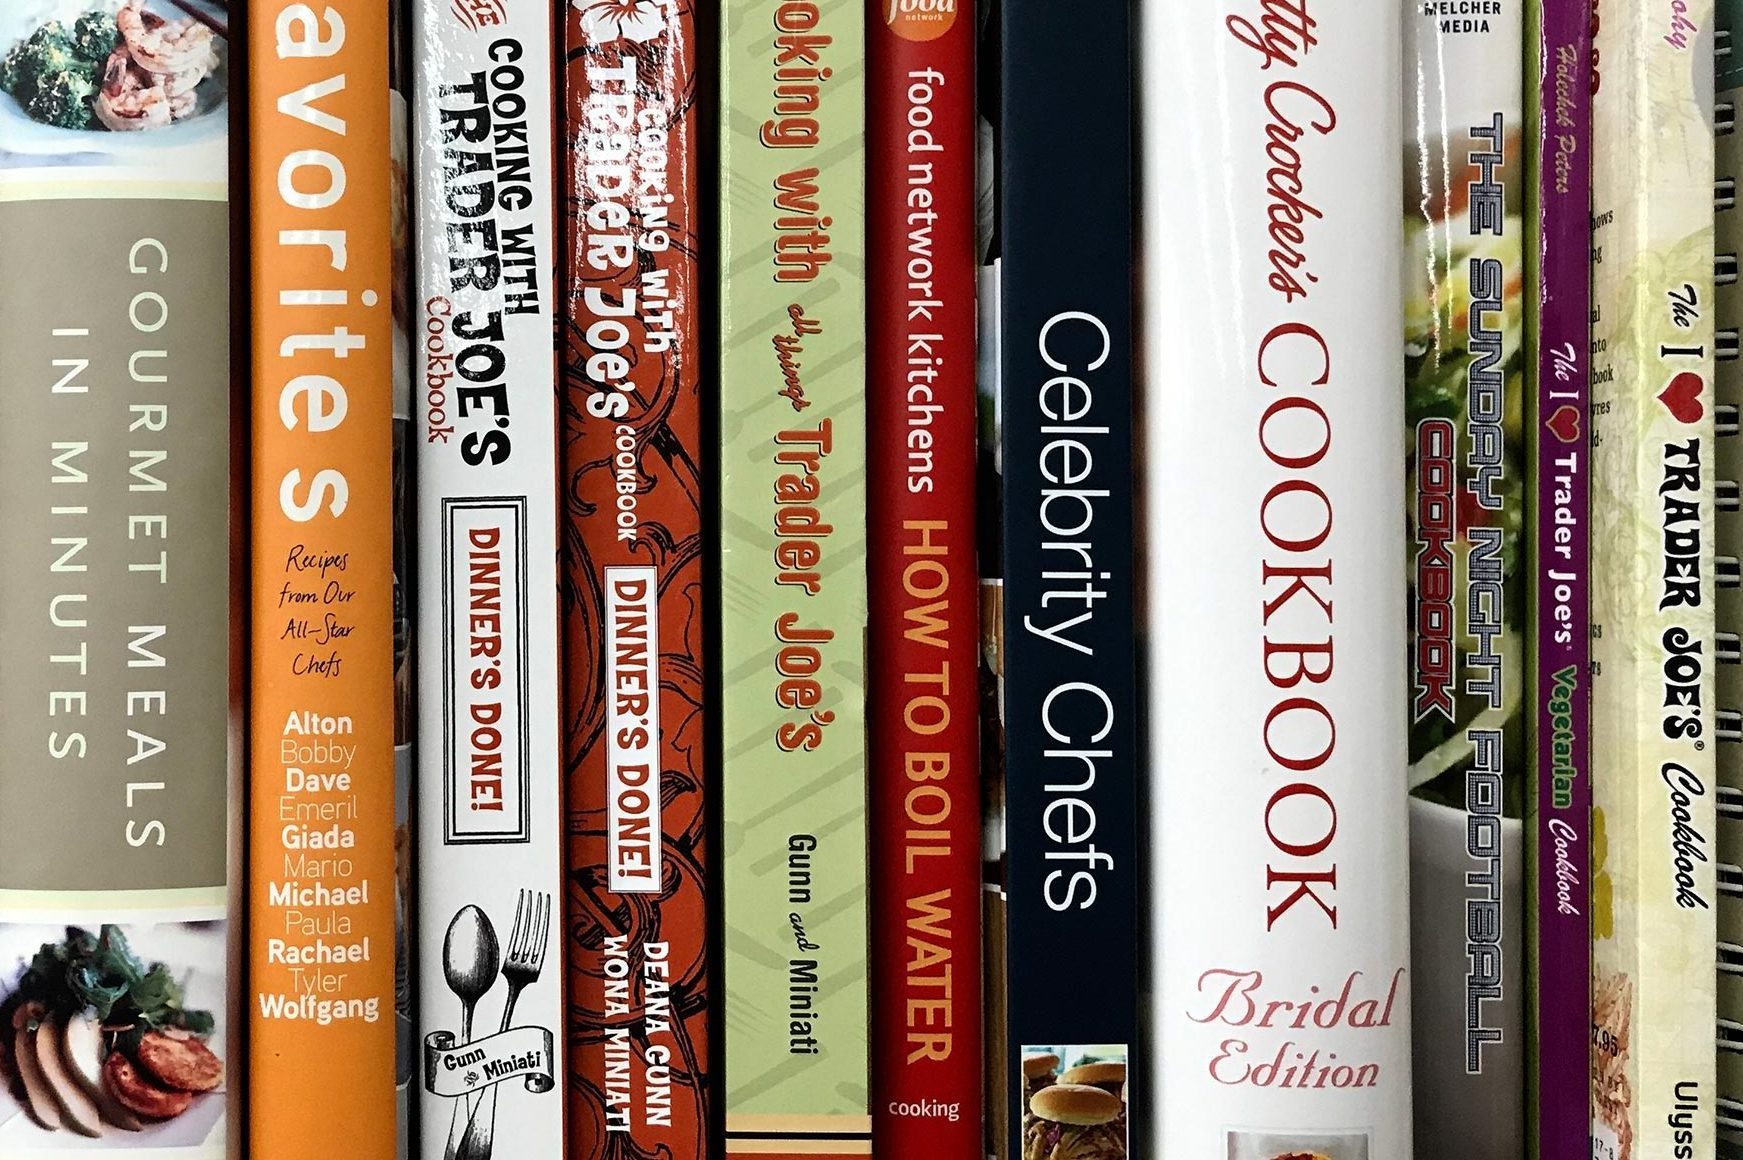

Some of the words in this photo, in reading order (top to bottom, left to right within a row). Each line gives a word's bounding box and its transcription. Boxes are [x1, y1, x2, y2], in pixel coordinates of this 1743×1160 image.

[905, 13, 944, 22] network
[1424, 1, 1501, 16] MELCHER
[1440, 19, 1490, 34] MEDIA
[760, 0, 832, 148] oking
[907, 67, 944, 152] food
[488, 38, 534, 211] COOKING
[1554, 135, 1577, 194] Peters
[439, 70, 502, 294] TRADER
[1262, 80, 1336, 304] Crocker's
[1468, 112, 1503, 236] THE
[276, 3, 378, 522] avorites
[501, 223, 540, 316] WITH
[773, 167, 832, 282] with
[907, 163, 944, 321] network
[787, 303, 822, 337] all
[1660, 345, 1704, 358] I
[1668, 284, 1699, 328] The
[51, 328, 89, 393] IN
[424, 297, 453, 445] Cookbook
[451, 305, 512, 467] JOE'S
[773, 333, 811, 412] things
[1467, 258, 1503, 510] SUNDAY
[1549, 390, 1578, 400] I
[1550, 342, 1577, 382] The
[128, 237, 168, 583] GOURMET
[907, 334, 944, 493] kitchens
[615, 424, 637, 542] COOKBOOK
[774, 417, 834, 596] Trader
[1024, 310, 1112, 656] Celebrity
[1555, 453, 1576, 560] Trader
[1659, 437, 1701, 611] TRADER
[49, 441, 88, 759] MINUTES
[279, 588, 317, 606] from
[324, 587, 356, 605] Our
[286, 545, 349, 573] Recipes
[902, 520, 950, 649] HOW
[1414, 418, 1456, 724] COOKBOOK
[281, 612, 355, 645] All-Star
[469, 527, 502, 690] DINNER'S
[1258, 322, 1337, 932] COOKBOOK
[1466, 528, 1503, 710] NIGHT
[292, 653, 341, 677] Chefs
[614, 579, 650, 750] DINNER'S
[775, 611, 835, 752] Joe's
[903, 661, 951, 735] TO
[125, 625, 167, 847] MEALS
[281, 740, 356, 769] Bobby
[283, 711, 352, 735] Alton
[470, 703, 503, 812] DONE!
[1548, 665, 1577, 809] Vegetarian
[279, 795, 357, 821] Emeril
[286, 768, 351, 793] Dave
[616, 764, 652, 879] DONE!
[904, 752, 952, 874] BOIL
[1042, 681, 1114, 912] Chefs
[281, 824, 354, 849] Giada
[284, 853, 352, 878] Mario
[787, 834, 817, 903] Gunn
[1549, 818, 1579, 916] Cookbook
[1661, 762, 1708, 910] Cookbook
[269, 881, 368, 906] Michael
[286, 911, 351, 935] Paula
[789, 912, 820, 952] and
[1465, 729, 1503, 1075] FOOTBALL
[268, 939, 369, 964] Rachael
[289, 967, 347, 995] Tyler
[603, 935, 630, 1018] WONA
[643, 941, 670, 1032] DEANA
[906, 888, 953, 1065] WATER
[1186, 967, 1406, 1029] Bridal
[259, 993, 379, 1024] Wolfgang
[789, 960, 819, 1055] Miniati
[444, 1047, 486, 1071] Gunn
[483, 1050, 541, 1081] Miniati
[604, 1027, 631, 1132] MINIATI
[645, 1045, 672, 1127] GUNN
[1208, 1039, 1380, 1089] Edition
[888, 1100, 960, 1122] cooking
[1668, 1081, 1699, 1159] Ulyss
